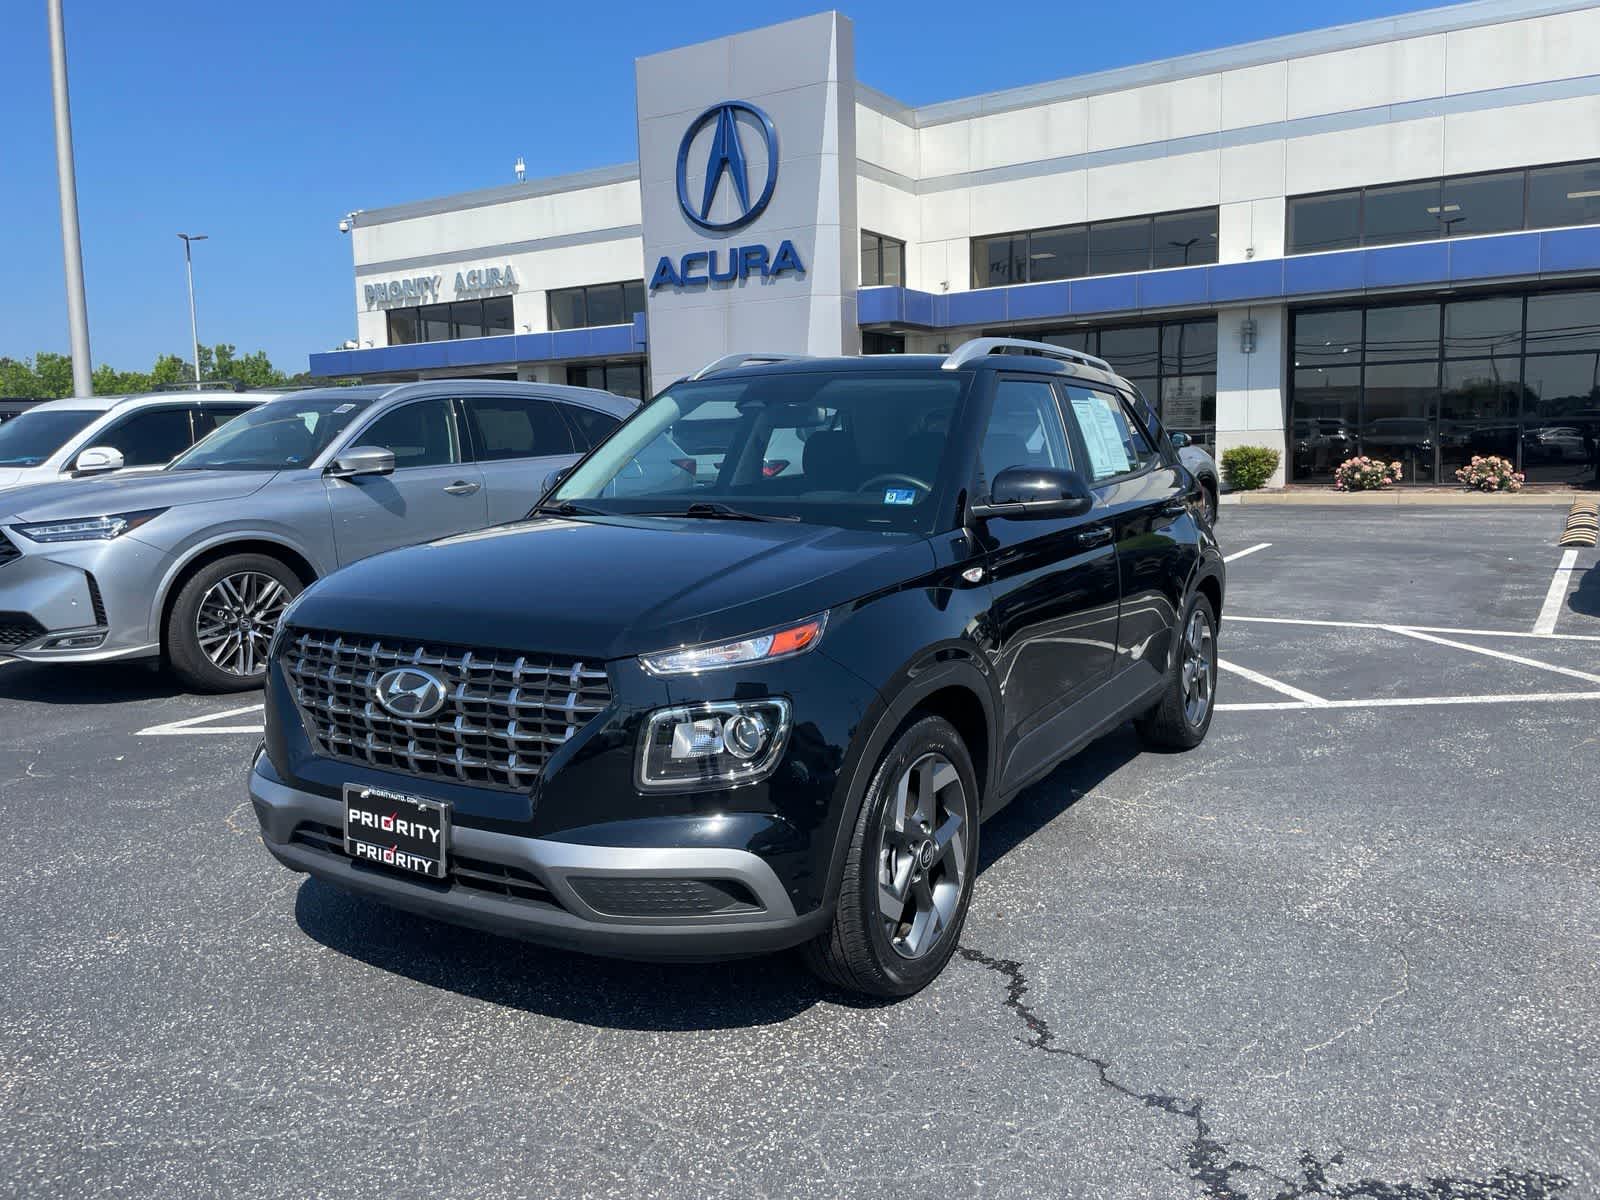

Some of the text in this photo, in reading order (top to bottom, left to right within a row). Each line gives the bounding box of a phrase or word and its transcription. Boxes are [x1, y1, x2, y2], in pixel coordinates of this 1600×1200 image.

[649, 240, 805, 289] ACURA
[364, 265, 517, 305] PRIORITY ACURA
[349, 808, 440, 843] PRIORITY
[356, 843, 432, 874] PRIORITY
